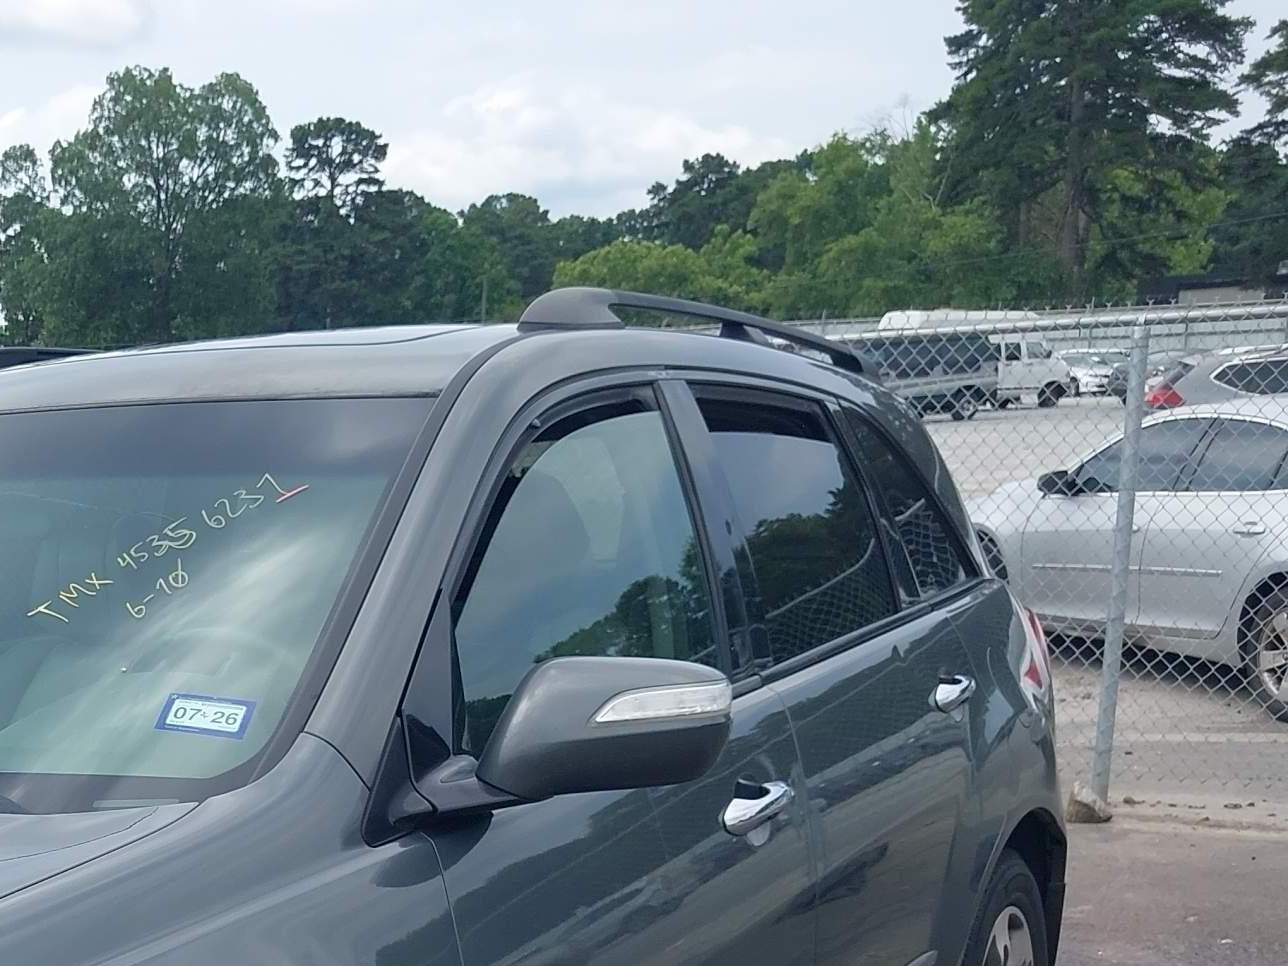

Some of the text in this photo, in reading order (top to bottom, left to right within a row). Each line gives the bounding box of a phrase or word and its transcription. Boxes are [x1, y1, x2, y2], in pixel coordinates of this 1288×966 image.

[26, 572, 114, 623] TMX
[117, 516, 196, 569] 4535
[126, 557, 189, 618] 6-10
